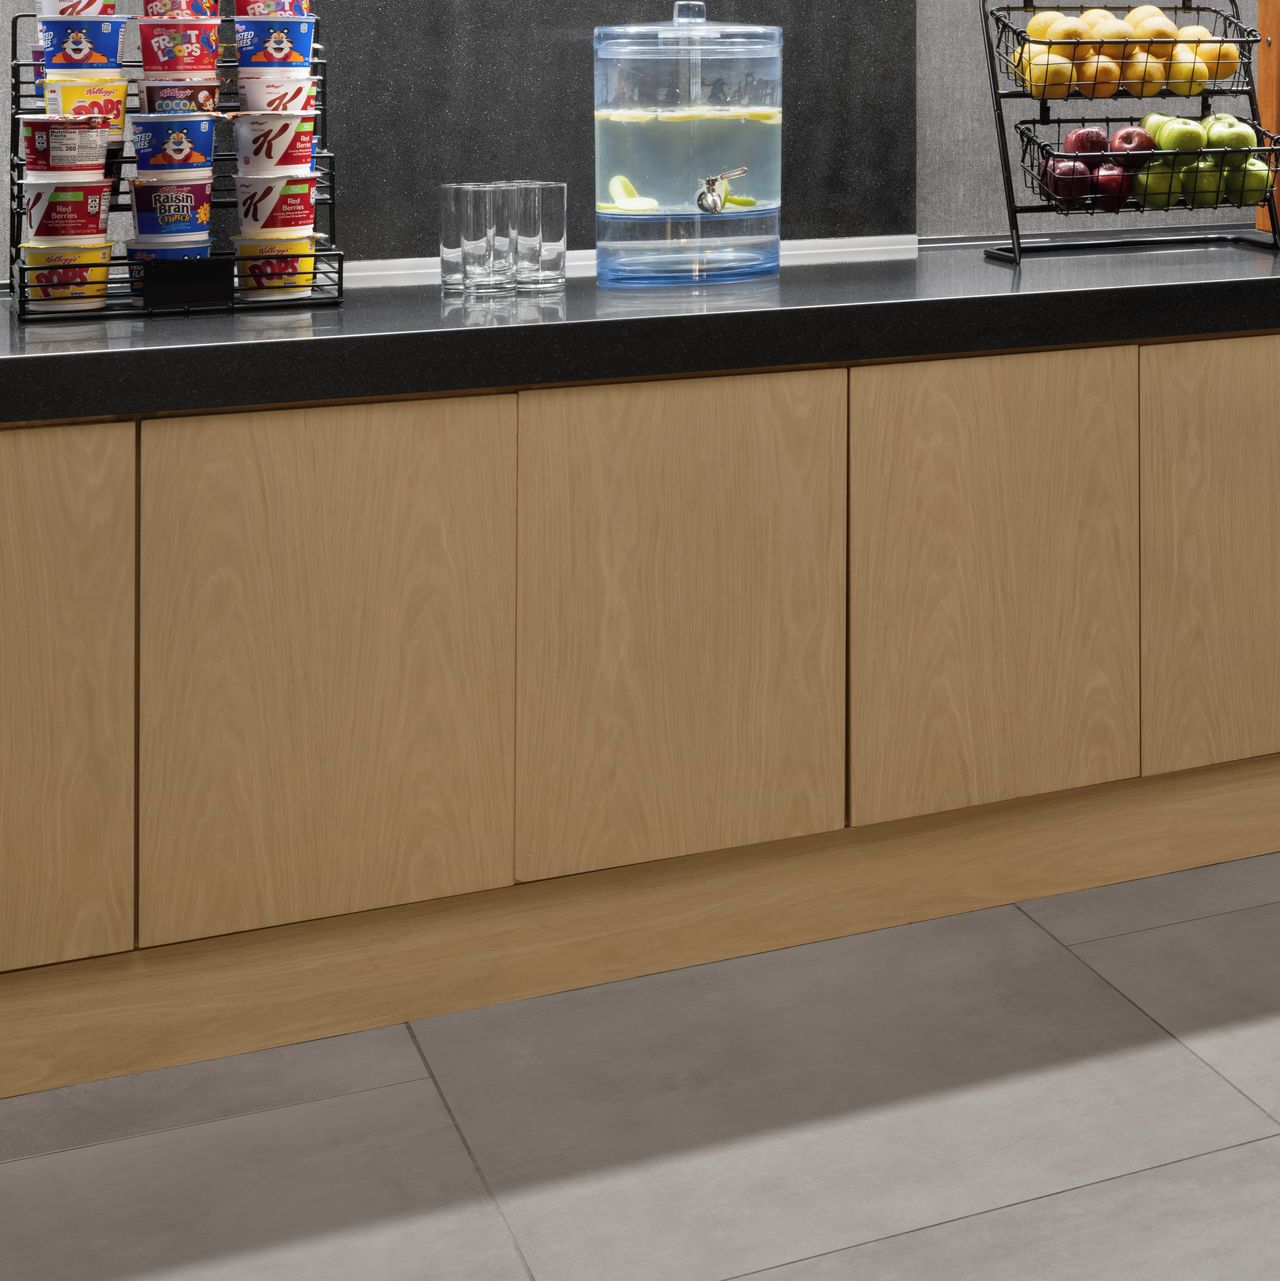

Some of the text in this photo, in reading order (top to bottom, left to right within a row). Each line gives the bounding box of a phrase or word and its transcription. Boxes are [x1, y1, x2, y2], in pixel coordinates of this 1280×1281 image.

[151, 30, 200, 51] FROOT
[157, 43, 201, 62] LOOPS
[155, 100, 197, 112] COCOA
[152, 193, 194, 205] Raisin
[157, 202, 190, 215] Bran
[282, 203, 304, 211] Berries
[51, 212, 78, 220] Berries
